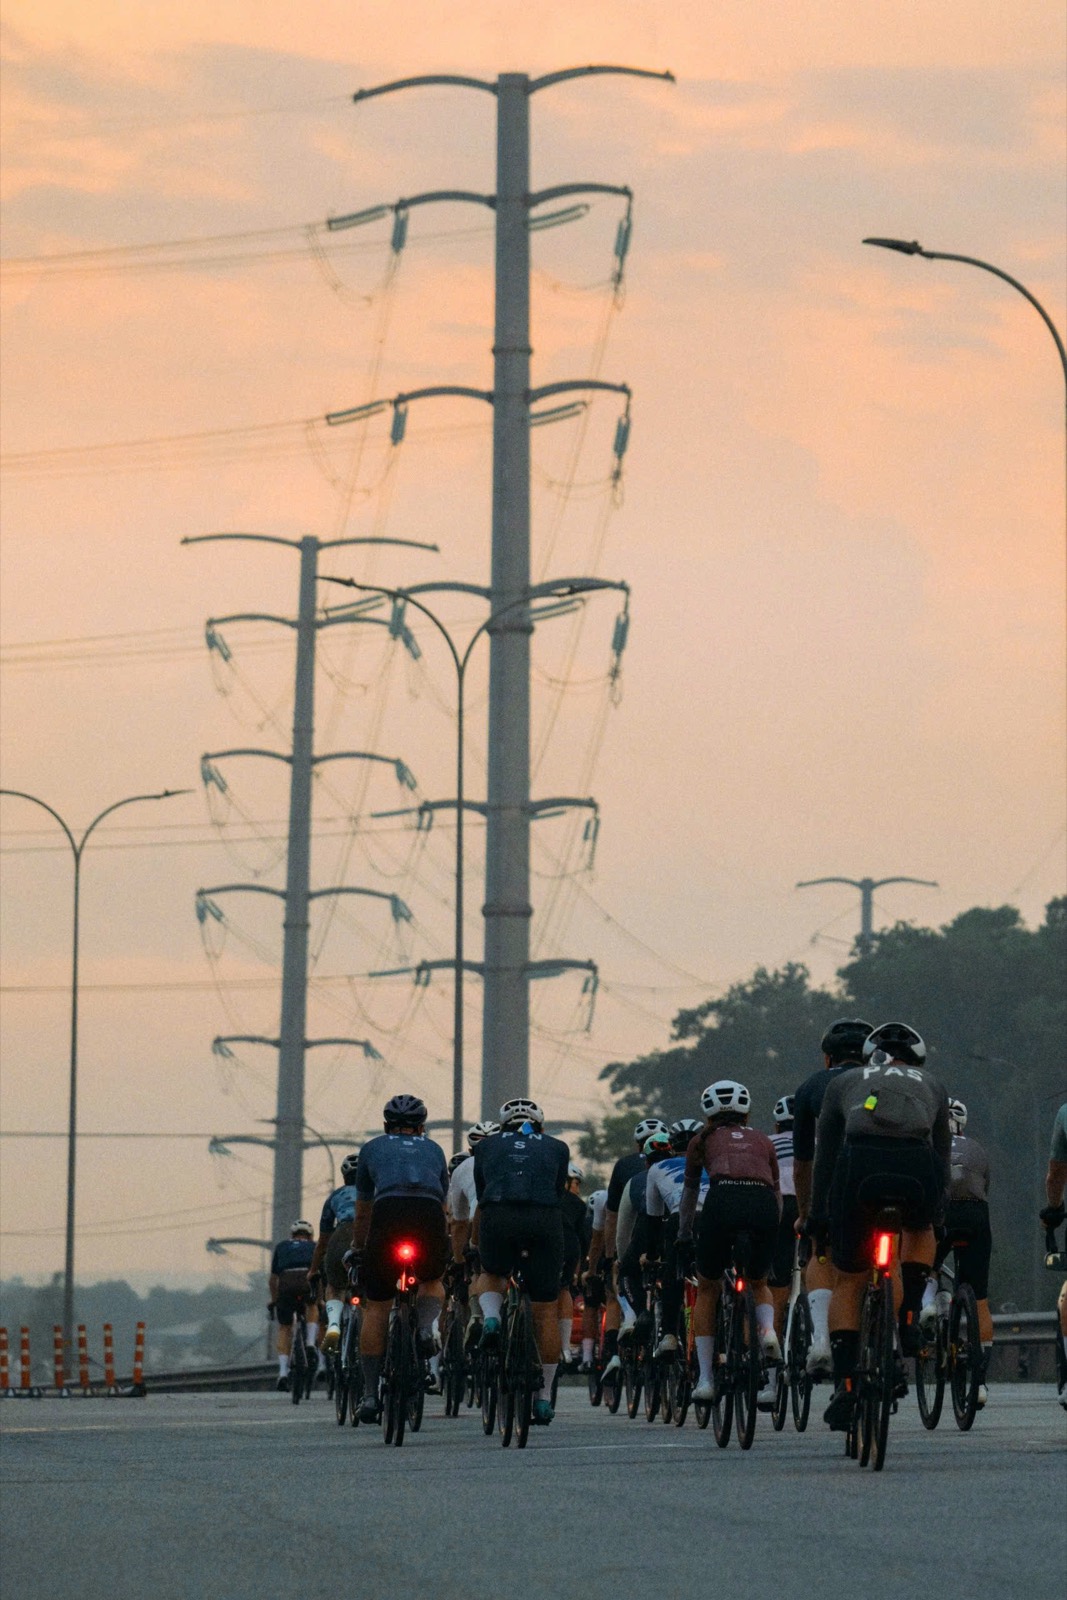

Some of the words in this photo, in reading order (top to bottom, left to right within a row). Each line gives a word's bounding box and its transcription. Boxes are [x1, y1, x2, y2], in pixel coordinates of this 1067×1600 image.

[863, 1066, 923, 1082] PAS
[731, 1131, 744, 1139] S
[514, 1141, 526, 1149] S
[718, 1179, 768, 1187] Mechanis
